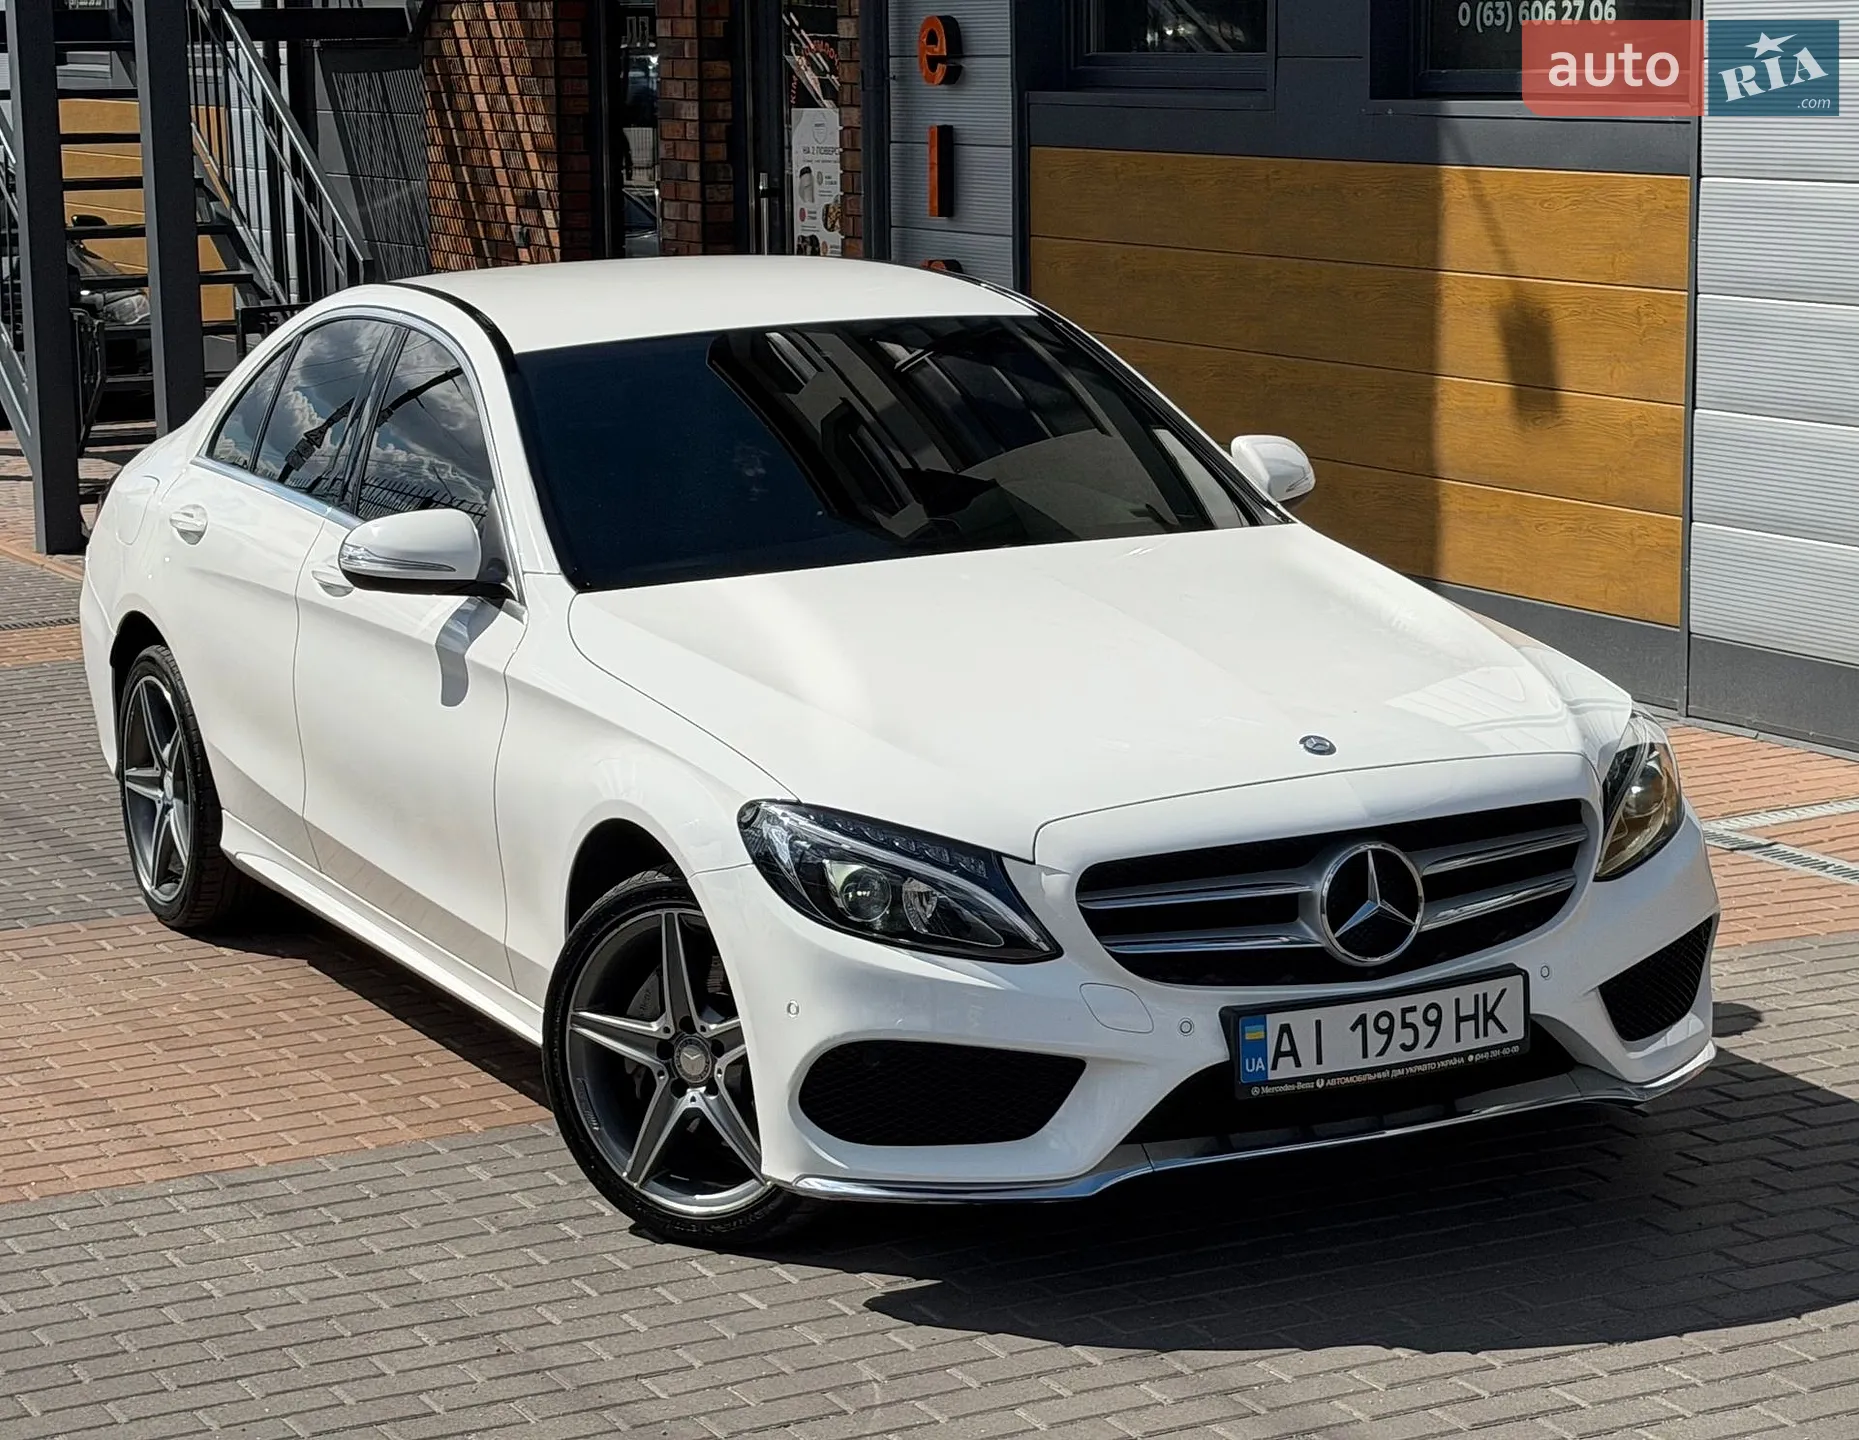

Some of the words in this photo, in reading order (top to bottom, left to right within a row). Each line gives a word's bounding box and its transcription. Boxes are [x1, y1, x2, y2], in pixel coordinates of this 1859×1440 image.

[1457, 1, 1471, 27] 0
[1476, 1, 1513, 33] (63)
[1518, 0, 1556, 26] 606
[1560, 0, 1585, 25] 27
[1589, 0, 1617, 25] 06
[1349, 1002, 1443, 1059] 1959
[1454, 987, 1509, 1044] HK
[1245, 1057, 1266, 1073] UA
[1261, 1081, 1315, 1095] Mercedes-Benz
